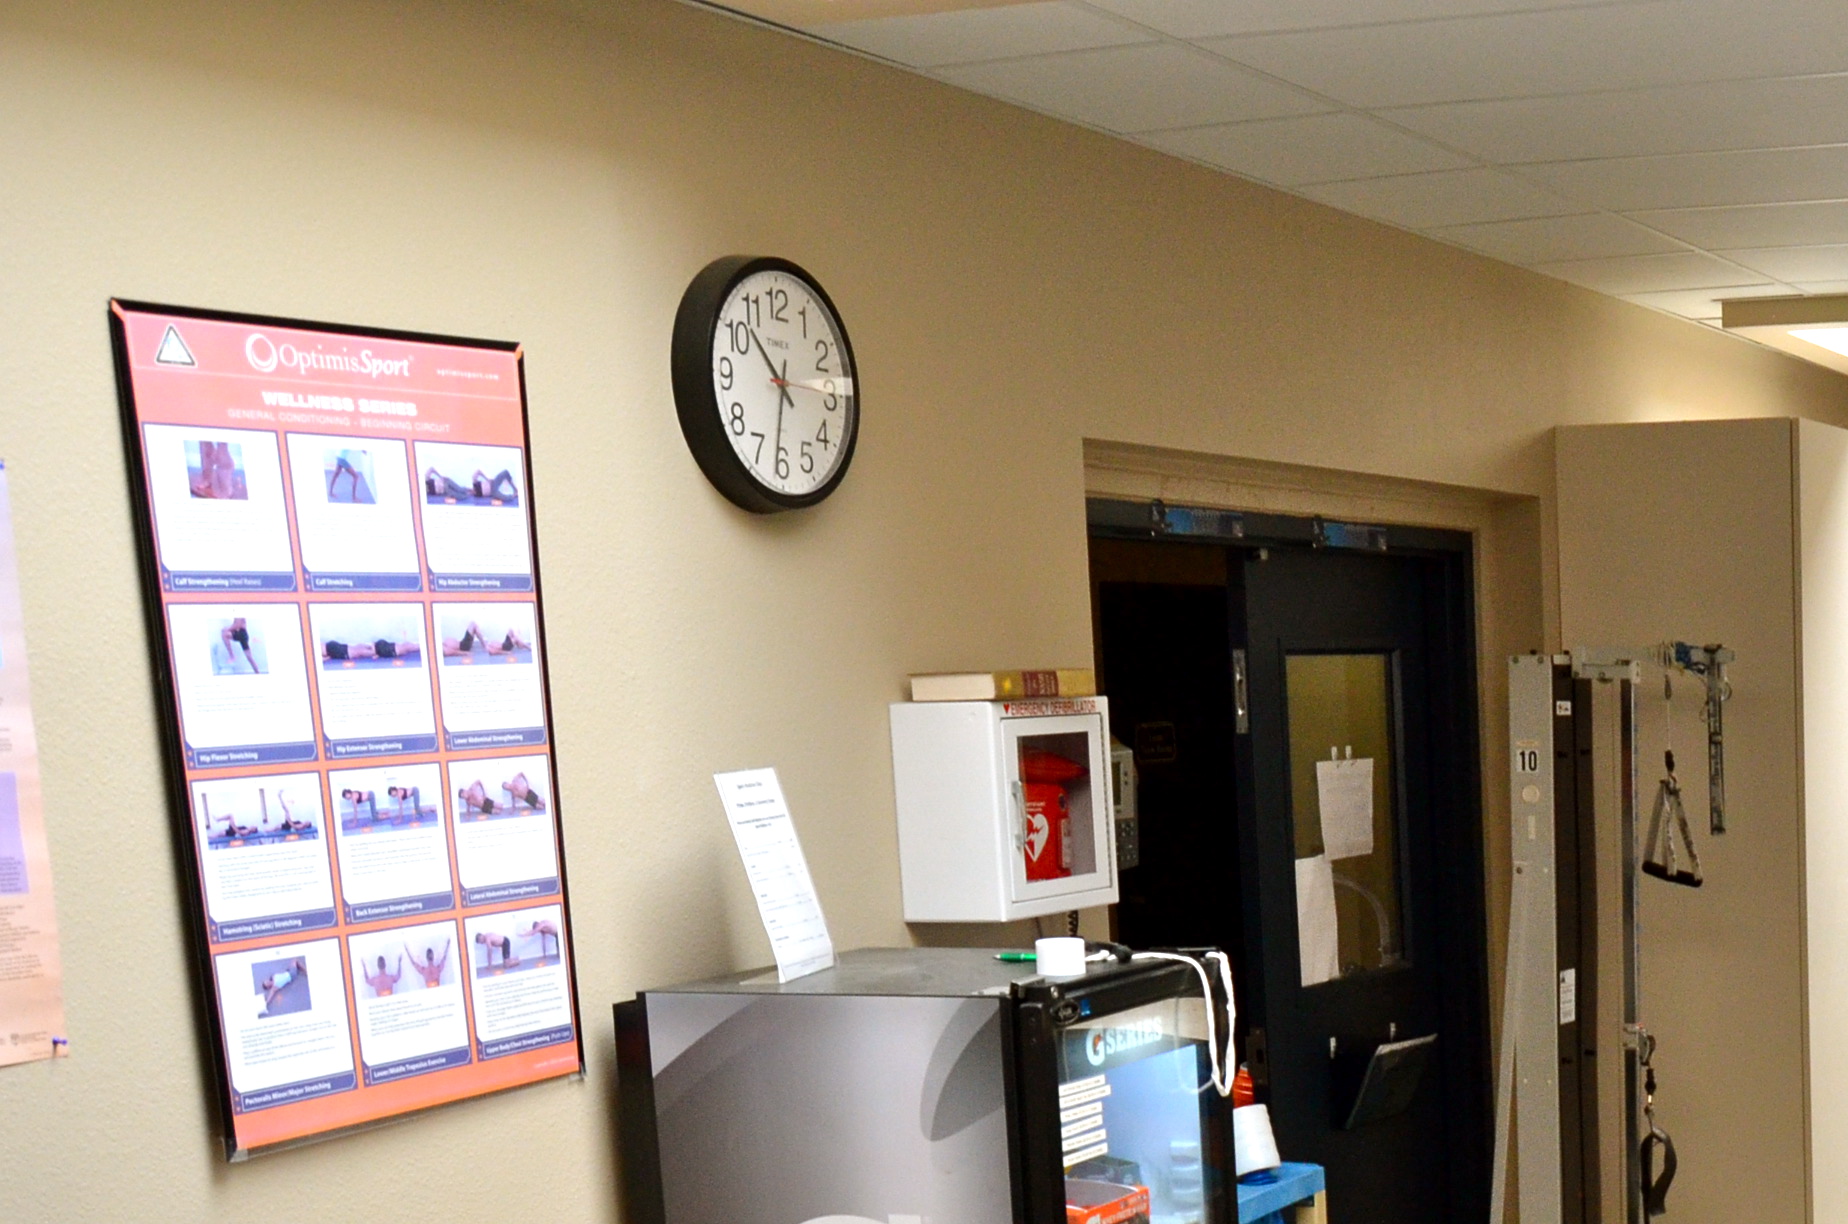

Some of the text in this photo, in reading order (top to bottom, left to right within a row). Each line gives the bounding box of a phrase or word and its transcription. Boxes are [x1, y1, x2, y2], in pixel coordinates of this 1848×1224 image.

[742, 292, 760, 328] 11
[766, 287, 789, 323] 12
[725, 319, 750, 355] 10
[798, 306, 807, 339] 1
[766, 338, 789, 350] TIMEX
[815, 339, 829, 373] 2
[279, 344, 410, 378] OptimisSport
[719, 356, 733, 391] 9
[262, 391, 418, 417] WELLNESS SERIES
[823, 379, 837, 411] 3
[228, 408, 275, 422] GENERAL
[278, 410, 350, 427] CONDITIONING
[360, 416, 412, 431] BEGINNING
[415, 419, 451, 433] CIRCUIT
[730, 402, 745, 436] 8
[816, 419, 830, 451] 4
[750, 432, 765, 465] 7
[777, 446, 789, 479] 6
[800, 441, 814, 473] 5
[1011, 700, 1096, 715] EMERGENCY DEFIBRILLATOR
[1519, 750, 1537, 771] 10
[1106, 1016, 1163, 1055] SERIES
